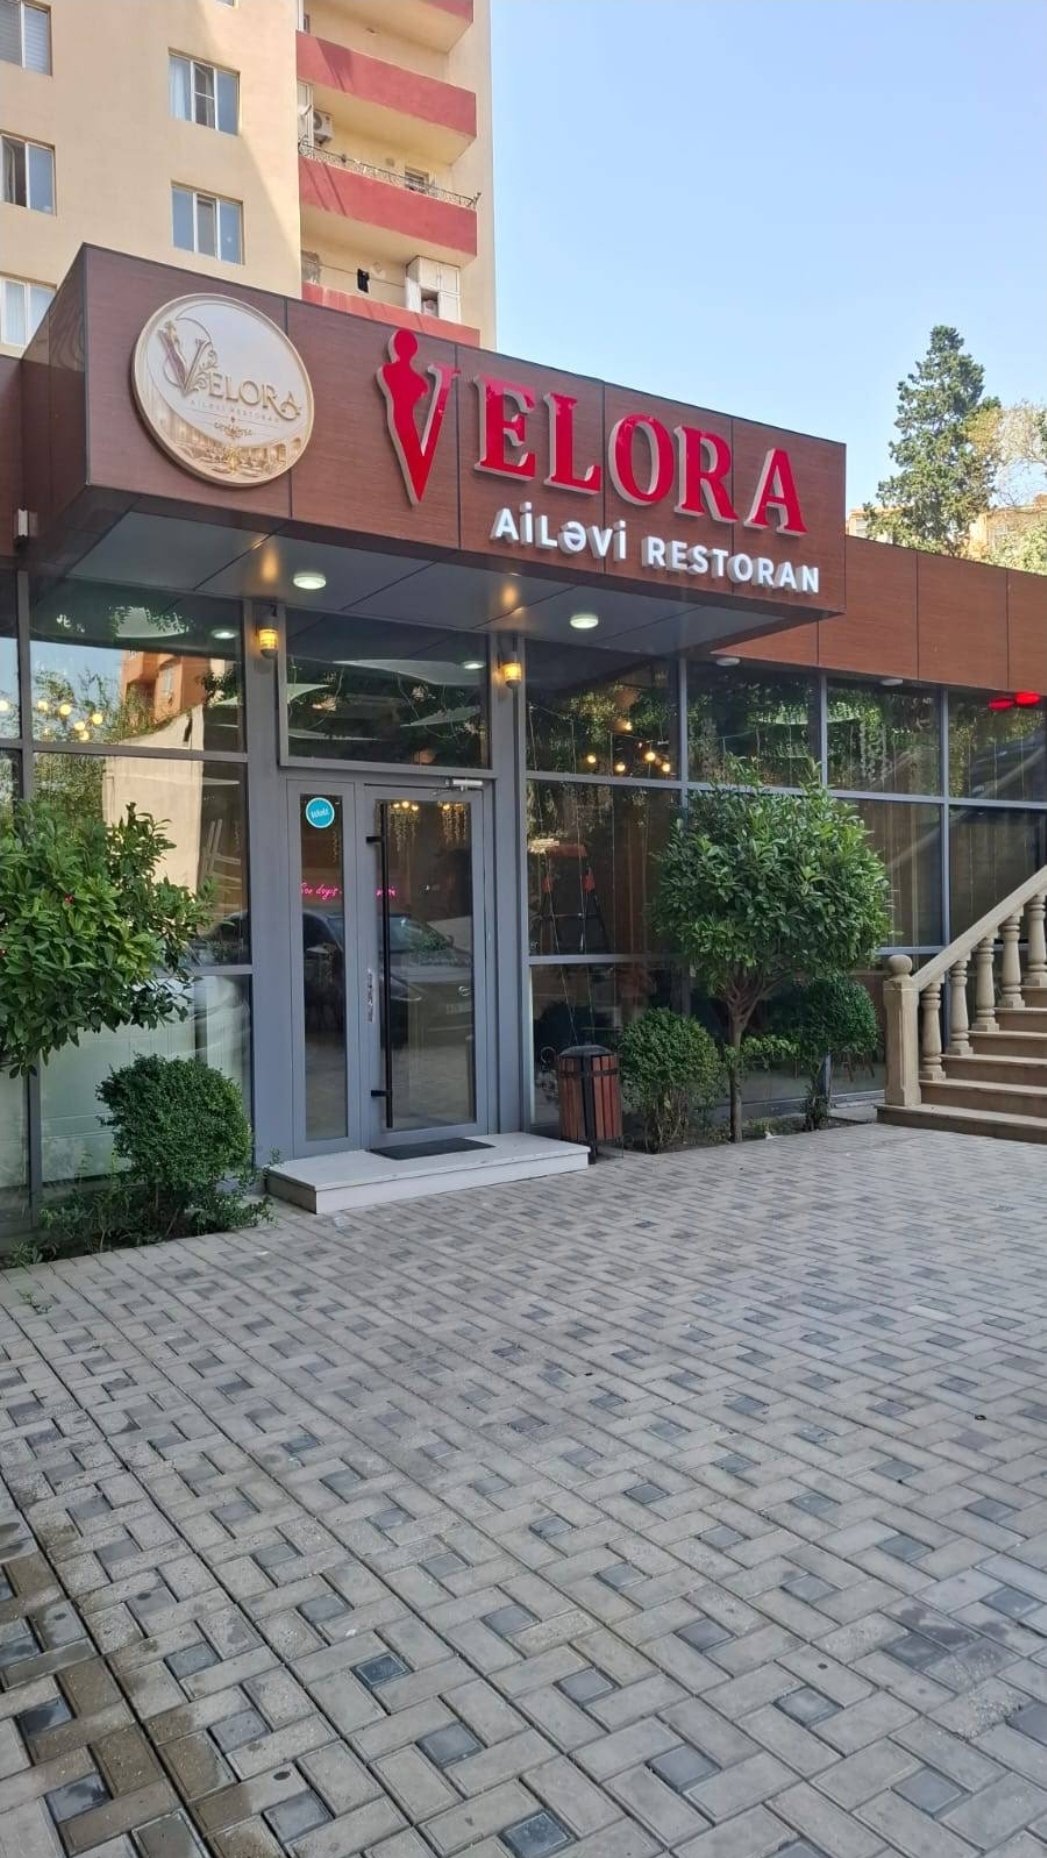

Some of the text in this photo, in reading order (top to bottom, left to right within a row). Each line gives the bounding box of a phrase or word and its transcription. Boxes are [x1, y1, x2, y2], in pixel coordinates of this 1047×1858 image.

[158, 321, 301, 421] VELORA
[377, 328, 807, 535] VELORA
[641, 536, 819, 593] RESTORAN
